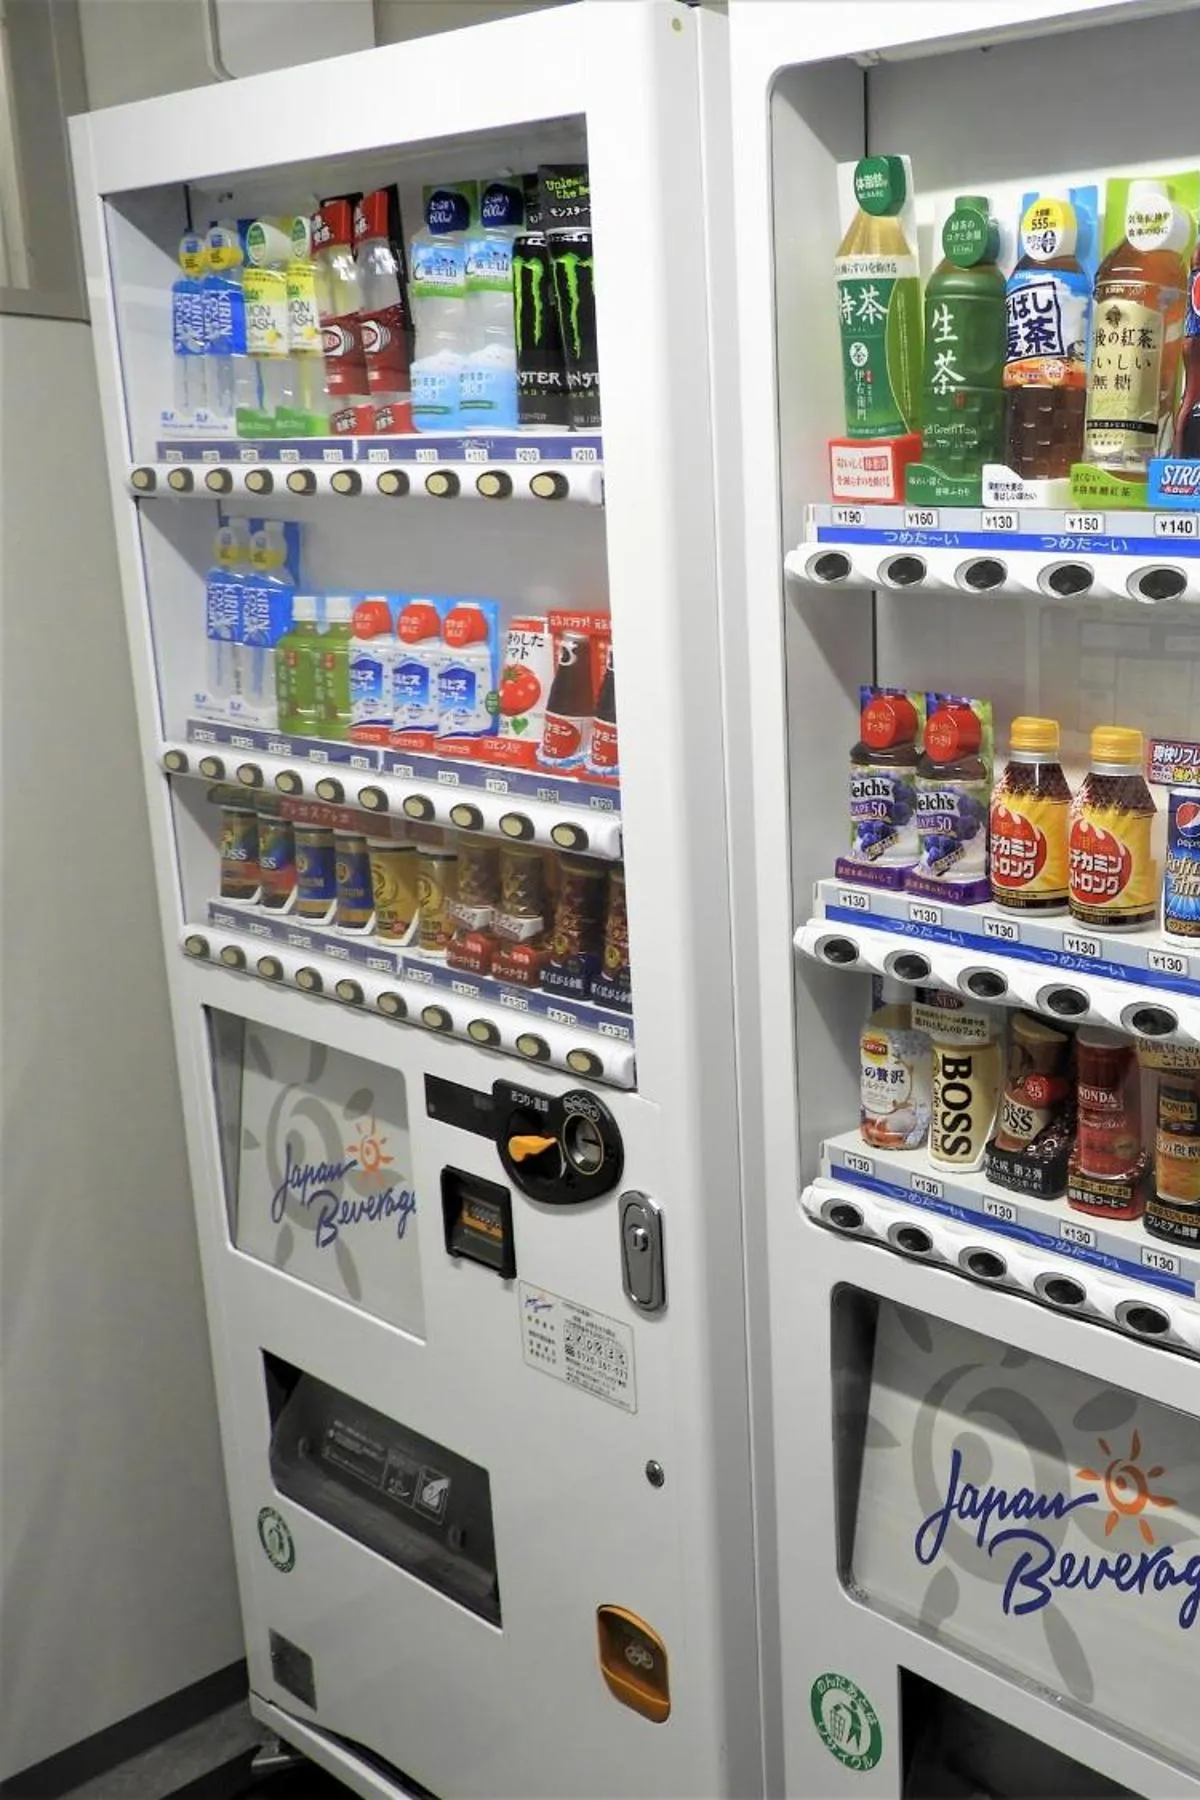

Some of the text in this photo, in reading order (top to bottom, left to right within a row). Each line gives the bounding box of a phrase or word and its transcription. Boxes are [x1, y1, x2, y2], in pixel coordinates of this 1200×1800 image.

[931, 303, 967, 395] 生茶
[1091, 374, 1132, 391] 無糖
[908, 513, 934, 525] ¥160
[985, 515, 1012, 528] ¥130
[1068, 517, 1098, 531] ¥150
[1159, 520, 1193, 534] ¥140
[850, 778, 891, 798] elch's
[870, 801, 888, 818] 50
[917, 792, 955, 812] elch's
[936, 817, 952, 833] 50
[912, 908, 938, 923] ¥130
[987, 923, 1014, 939] ¥130
[1067, 939, 1096, 956] ¥130
[1152, 955, 1183, 972] ¥130
[941, 1053, 973, 1156] BOSS
[846, 1156, 870, 1172] ¥130
[271, 1143, 357, 1223] Japan
[914, 1178, 939, 1195] ¥130
[986, 1203, 1013, 1220] ¥130
[1063, 1227, 1091, 1245] ¥130
[1146, 1253, 1174, 1271] ¥130
[914, 1448, 1099, 1566] Japan
